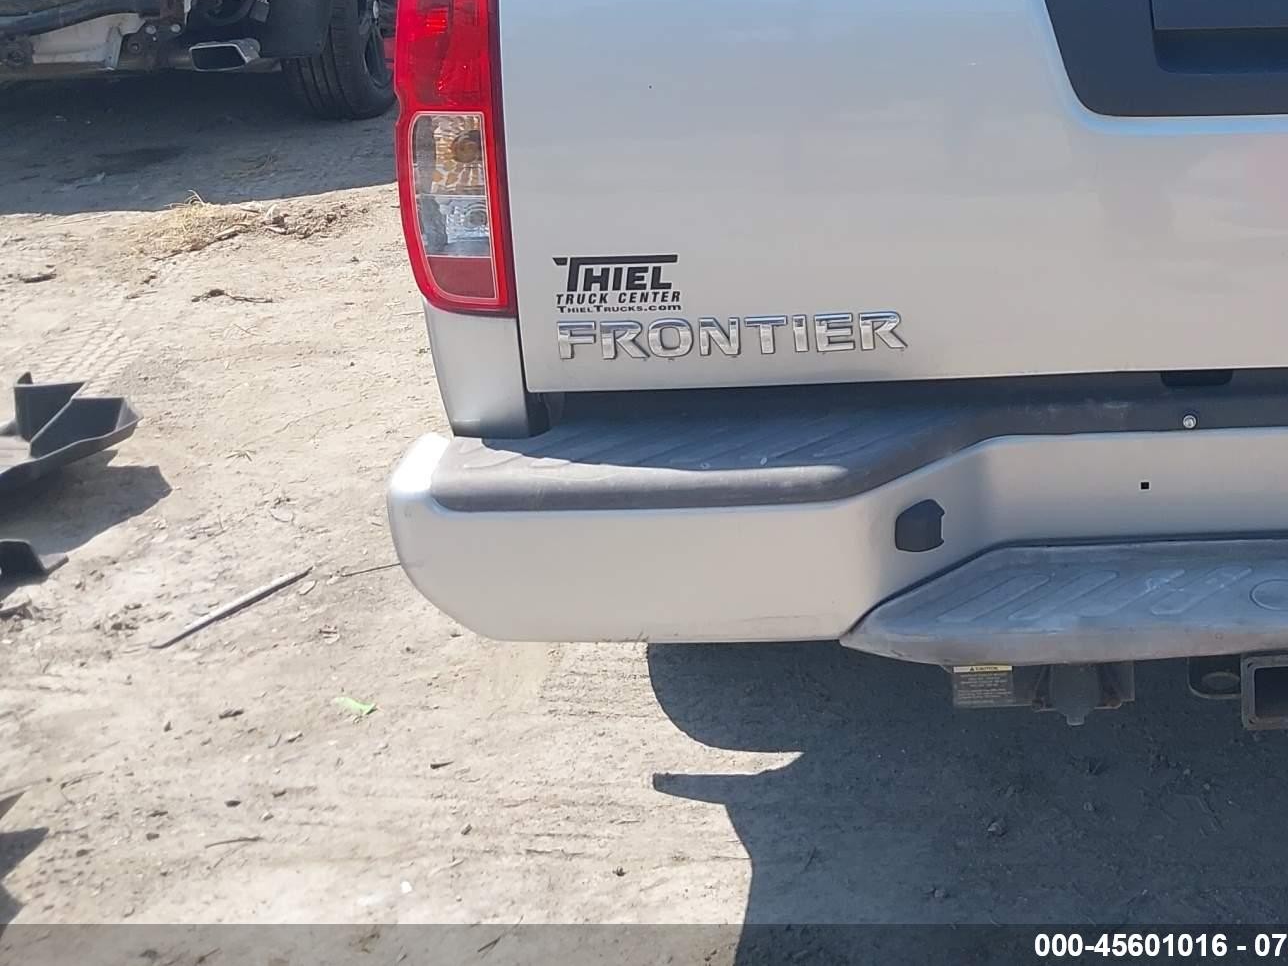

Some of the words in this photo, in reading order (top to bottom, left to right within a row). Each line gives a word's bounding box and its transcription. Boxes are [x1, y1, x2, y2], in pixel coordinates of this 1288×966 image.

[552, 254, 679, 292] THIEL
[556, 292, 609, 305] TRUCK
[618, 290, 681, 304] CENTER
[556, 310, 908, 360] FRONTIER
